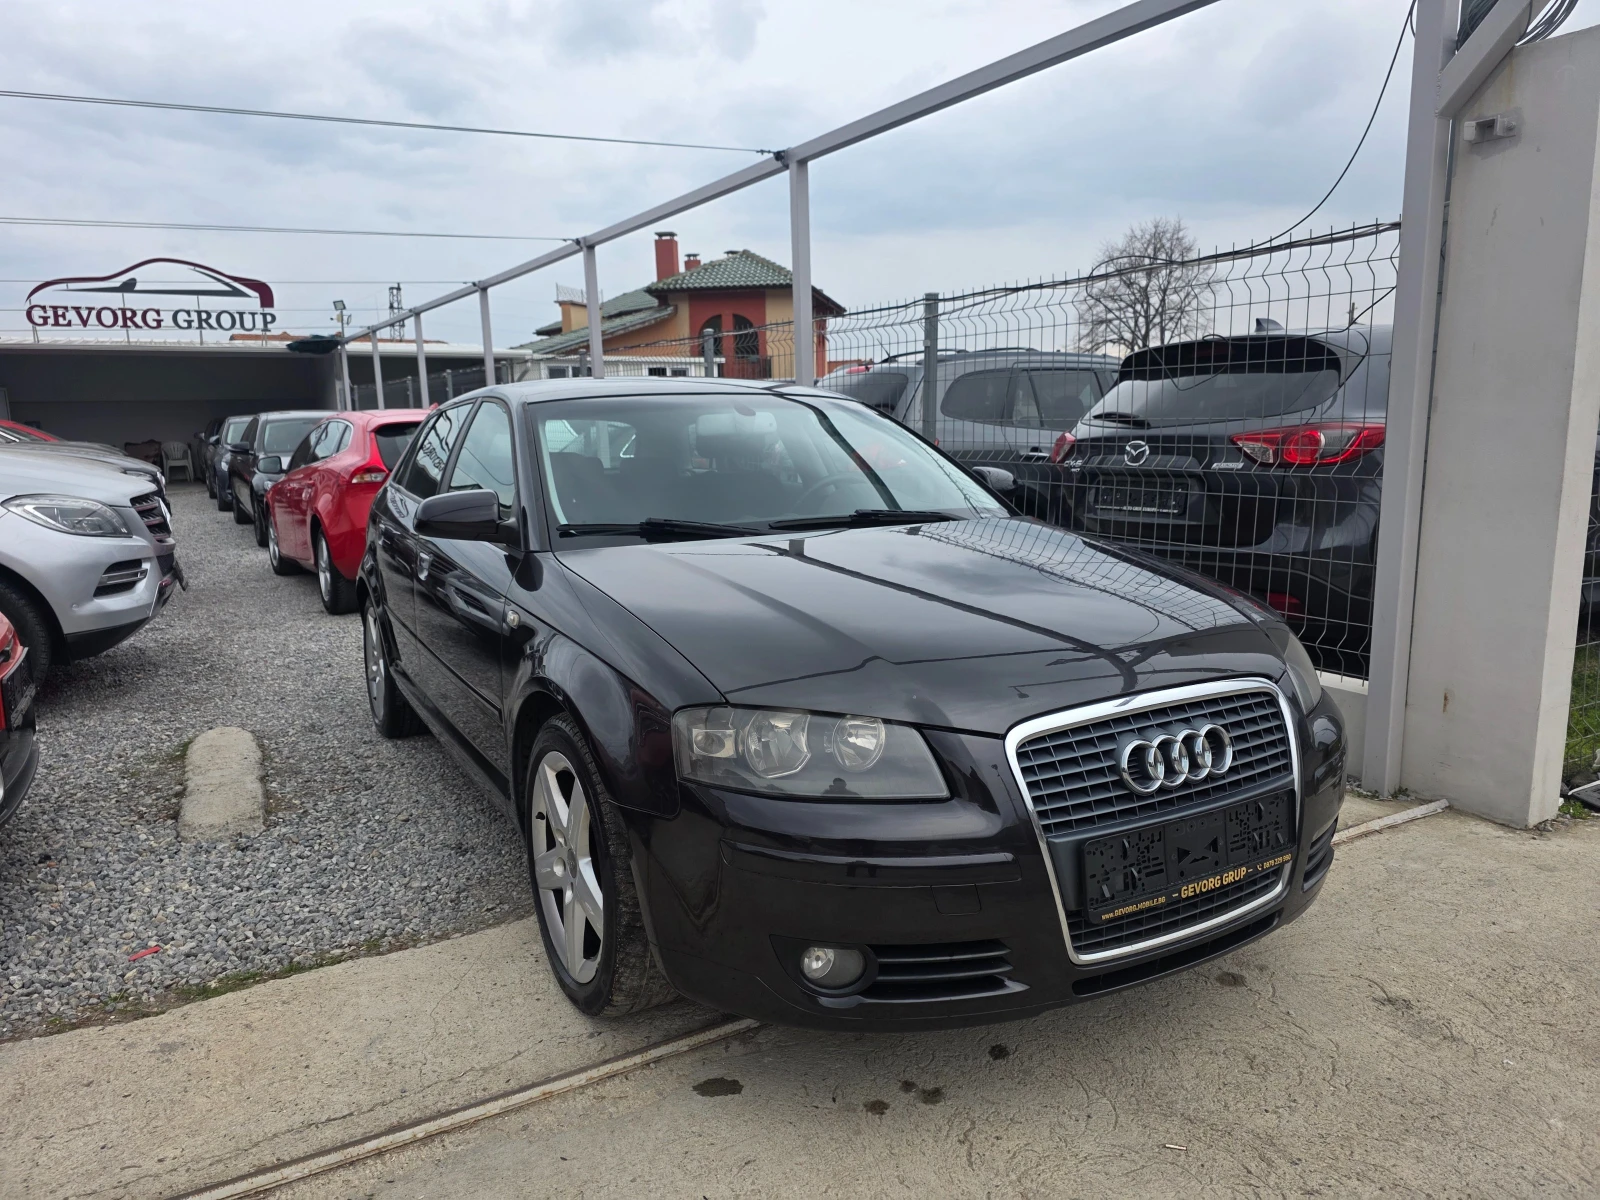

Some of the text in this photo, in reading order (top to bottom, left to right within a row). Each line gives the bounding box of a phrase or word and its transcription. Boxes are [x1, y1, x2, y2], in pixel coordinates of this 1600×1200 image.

[25, 304, 277, 332] GEVORG GROUP
[1181, 875, 1221, 899] GEVORG
[1222, 866, 1247, 885] GRUP
